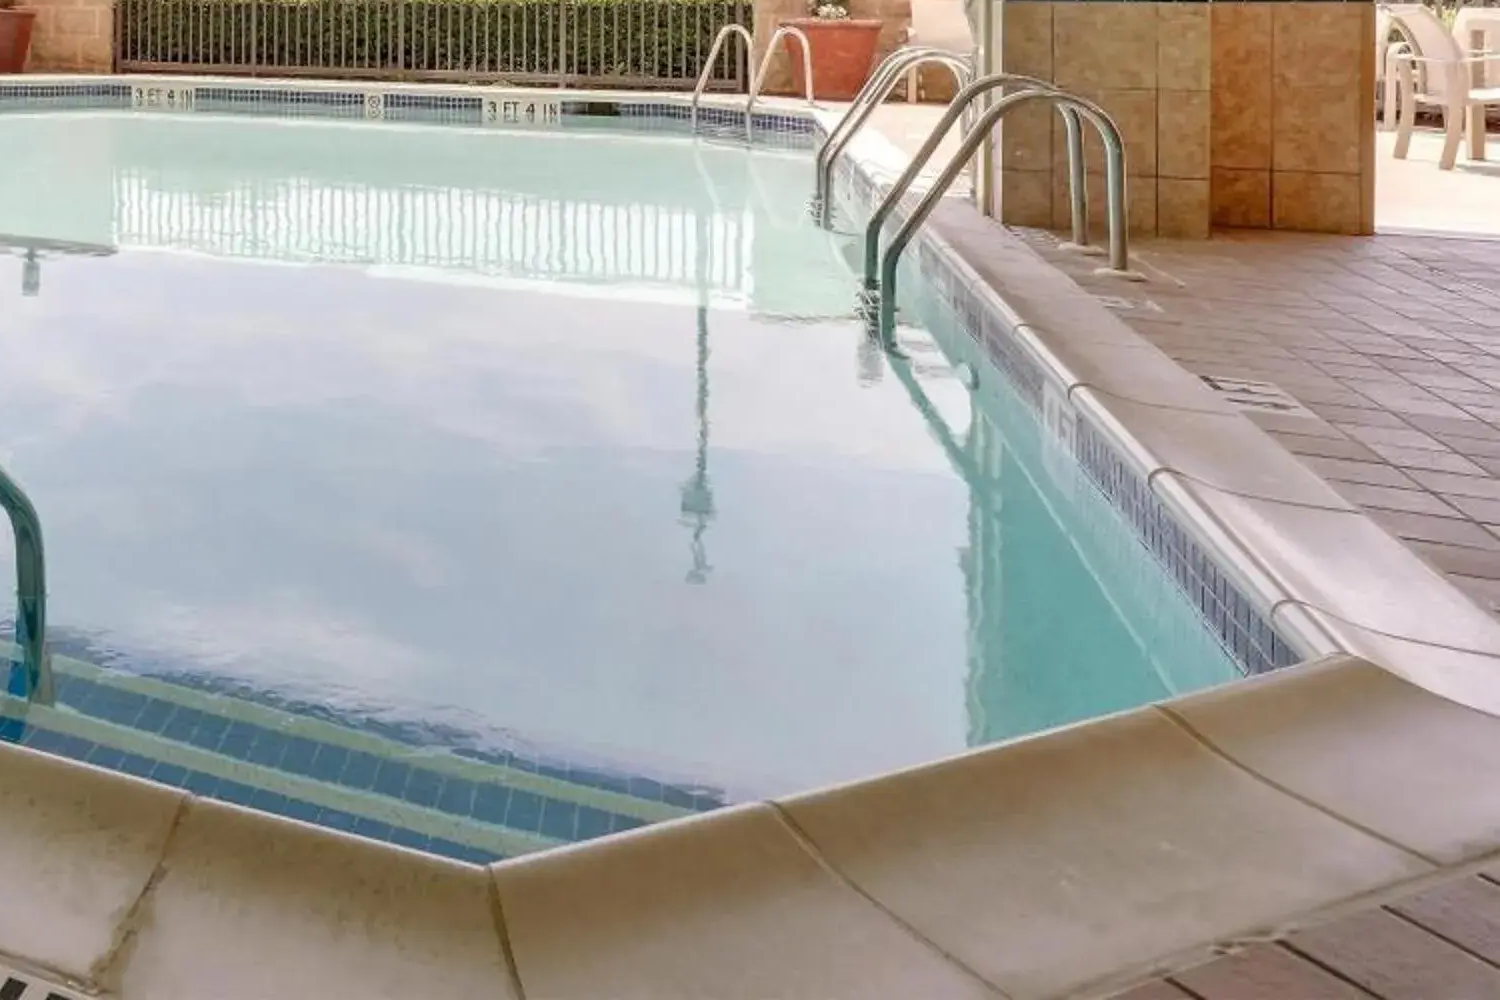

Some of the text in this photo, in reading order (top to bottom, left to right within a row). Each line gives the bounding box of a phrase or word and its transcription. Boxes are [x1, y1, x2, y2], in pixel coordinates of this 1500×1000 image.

[488, 101, 558, 116] 3 FT 4 IN
